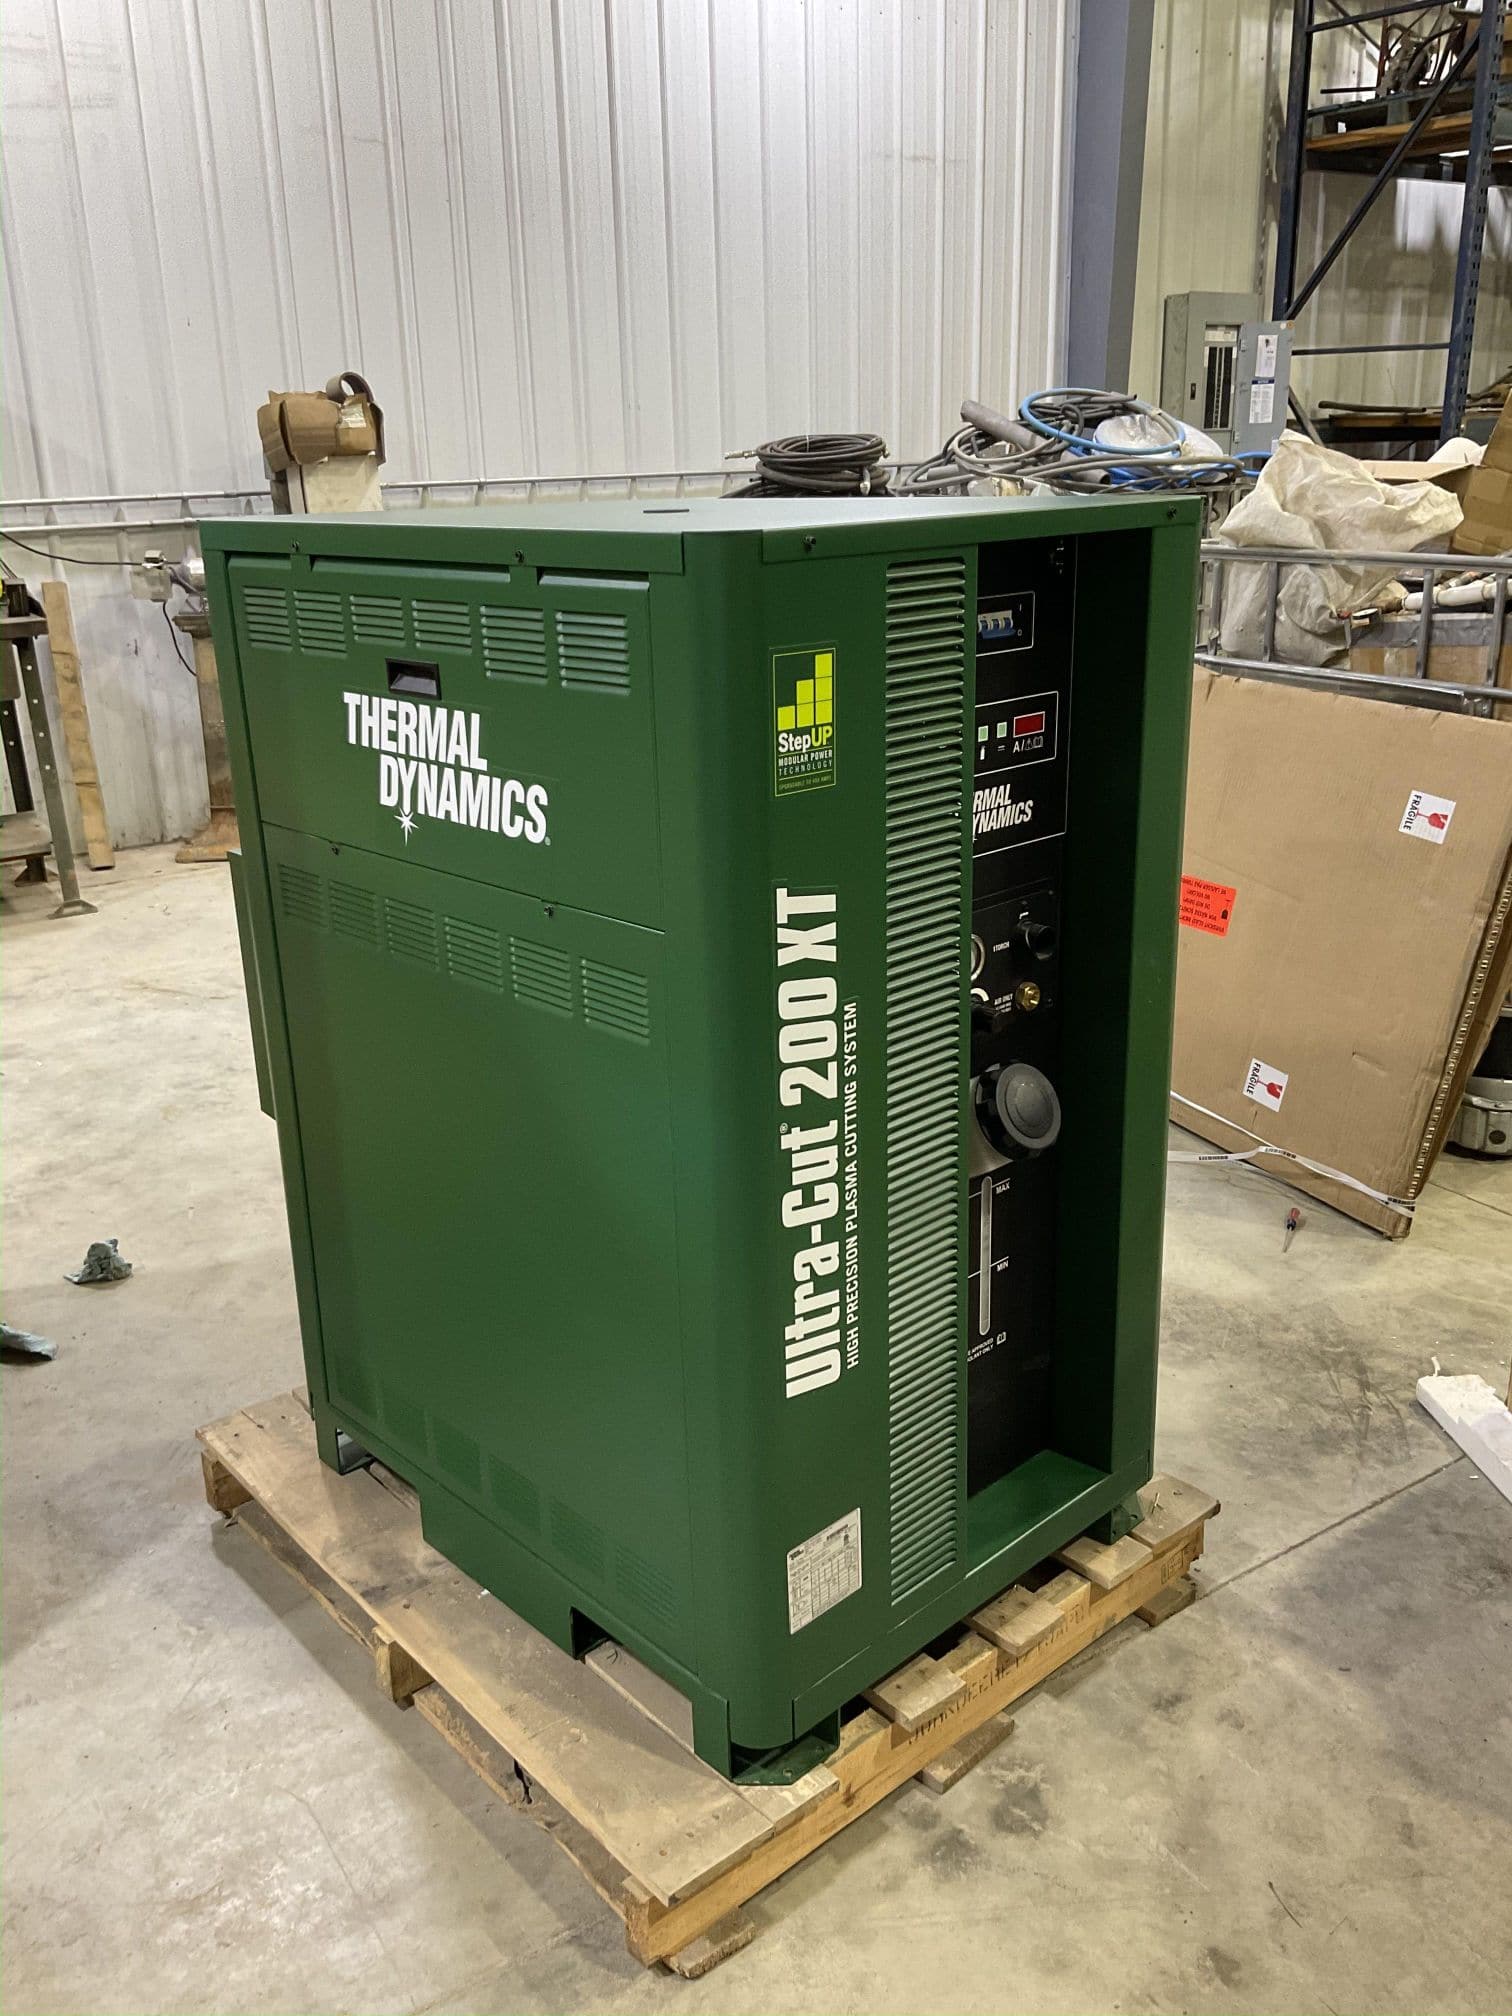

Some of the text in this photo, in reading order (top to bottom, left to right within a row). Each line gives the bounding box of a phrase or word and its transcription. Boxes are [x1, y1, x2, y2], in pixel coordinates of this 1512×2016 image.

[343, 691, 488, 771] THERMAL
[778, 726, 833, 753] StepUP
[778, 750, 833, 767] MODULAR POWER
[778, 760, 833, 776] TECHNOLOGY
[379, 754, 549, 844] DYNAMICS
[973, 784, 1012, 813] RMAL
[1403, 794, 1422, 831] FRAGILE
[972, 800, 1034, 836] YNAMICS
[776, 887, 837, 967] XT
[778, 976, 838, 1106] 200
[1246, 1062, 1261, 1095] FRAGILE
[843, 1002, 859, 1370] HIGH PRECISION PLASMA CUTTING SYSTEM
[996, 1182, 1010, 1194] MAX
[997, 1261, 1009, 1272] MIN
